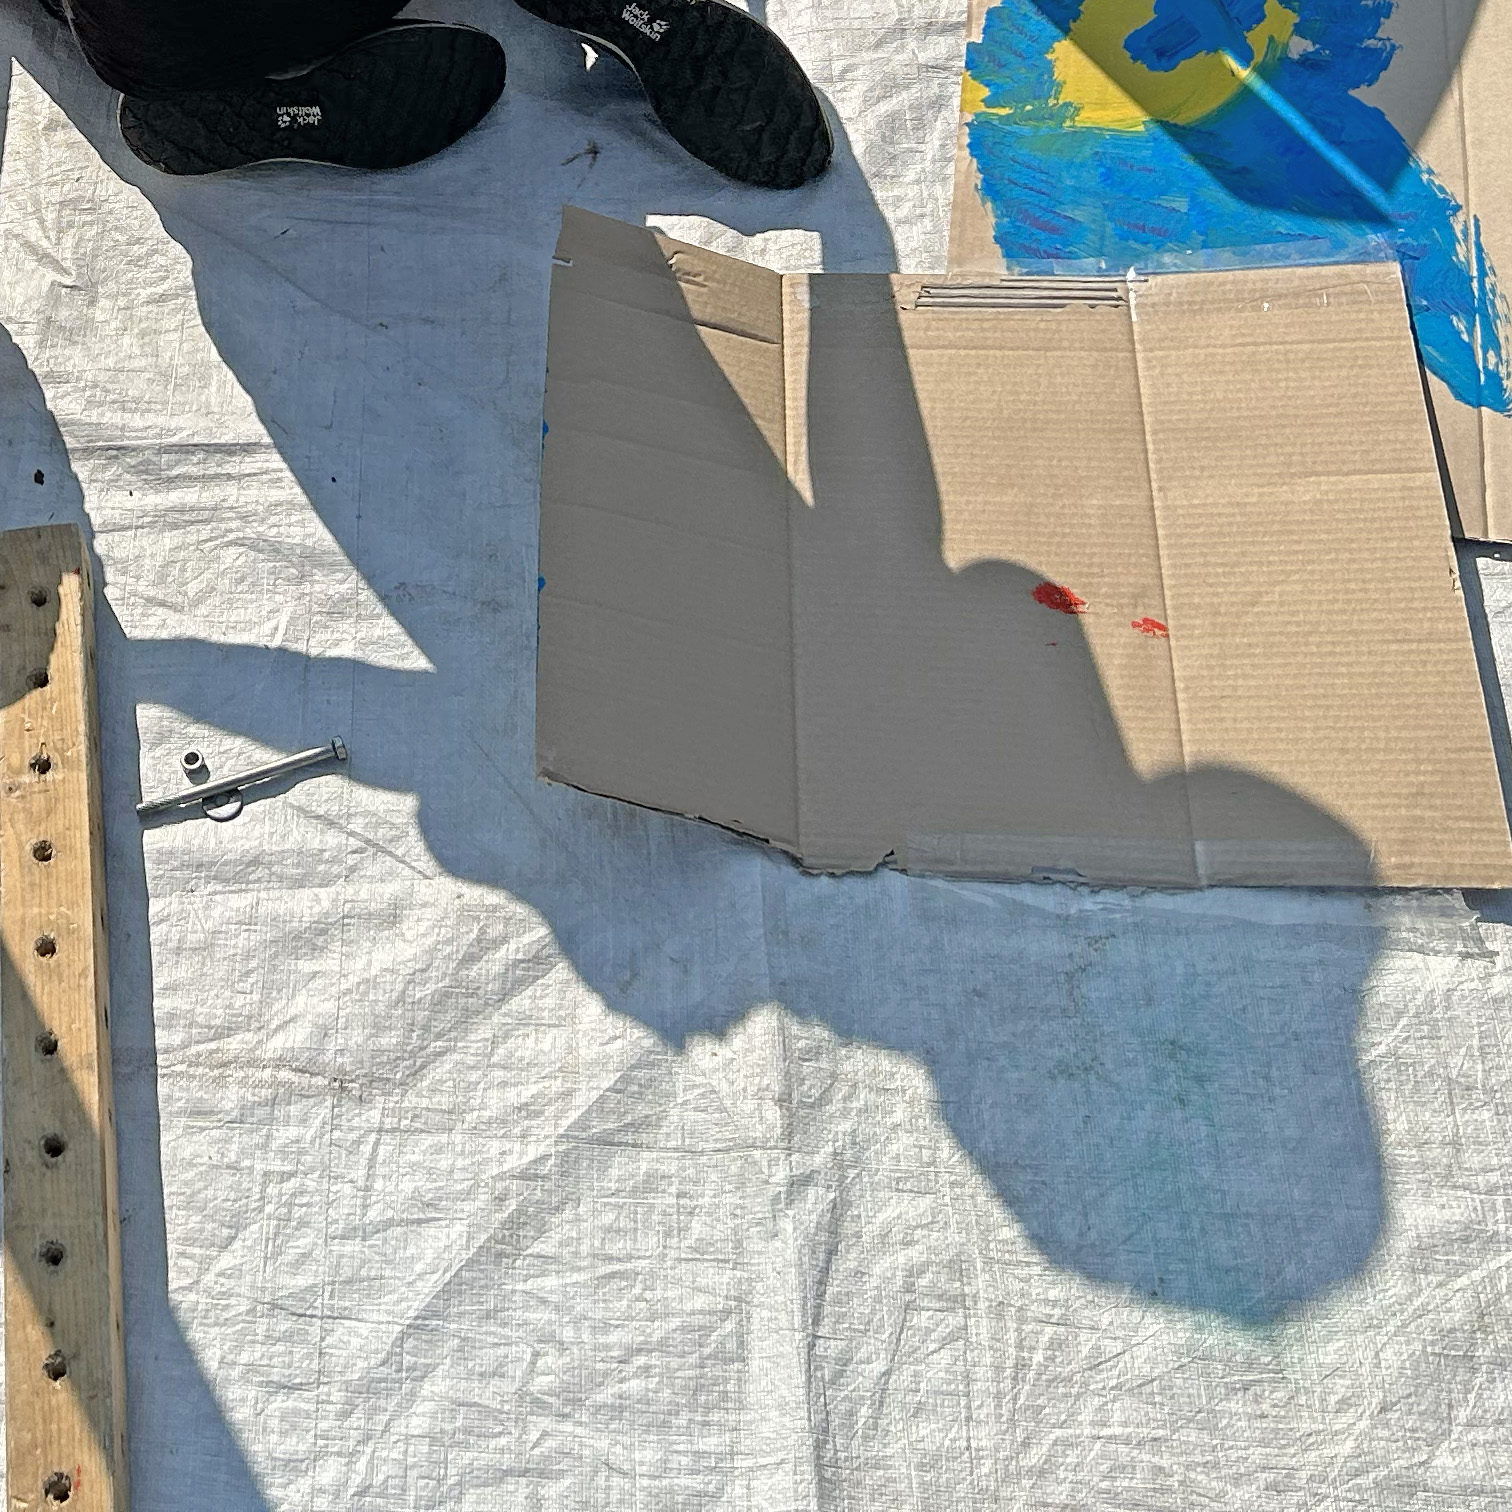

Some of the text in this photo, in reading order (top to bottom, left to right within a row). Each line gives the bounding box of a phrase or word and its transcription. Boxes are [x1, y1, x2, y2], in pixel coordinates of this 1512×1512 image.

[625, 2, 650, 22] Jack
[621, 8, 661, 41] Wolfskin
[296, 114, 322, 126] Jack
